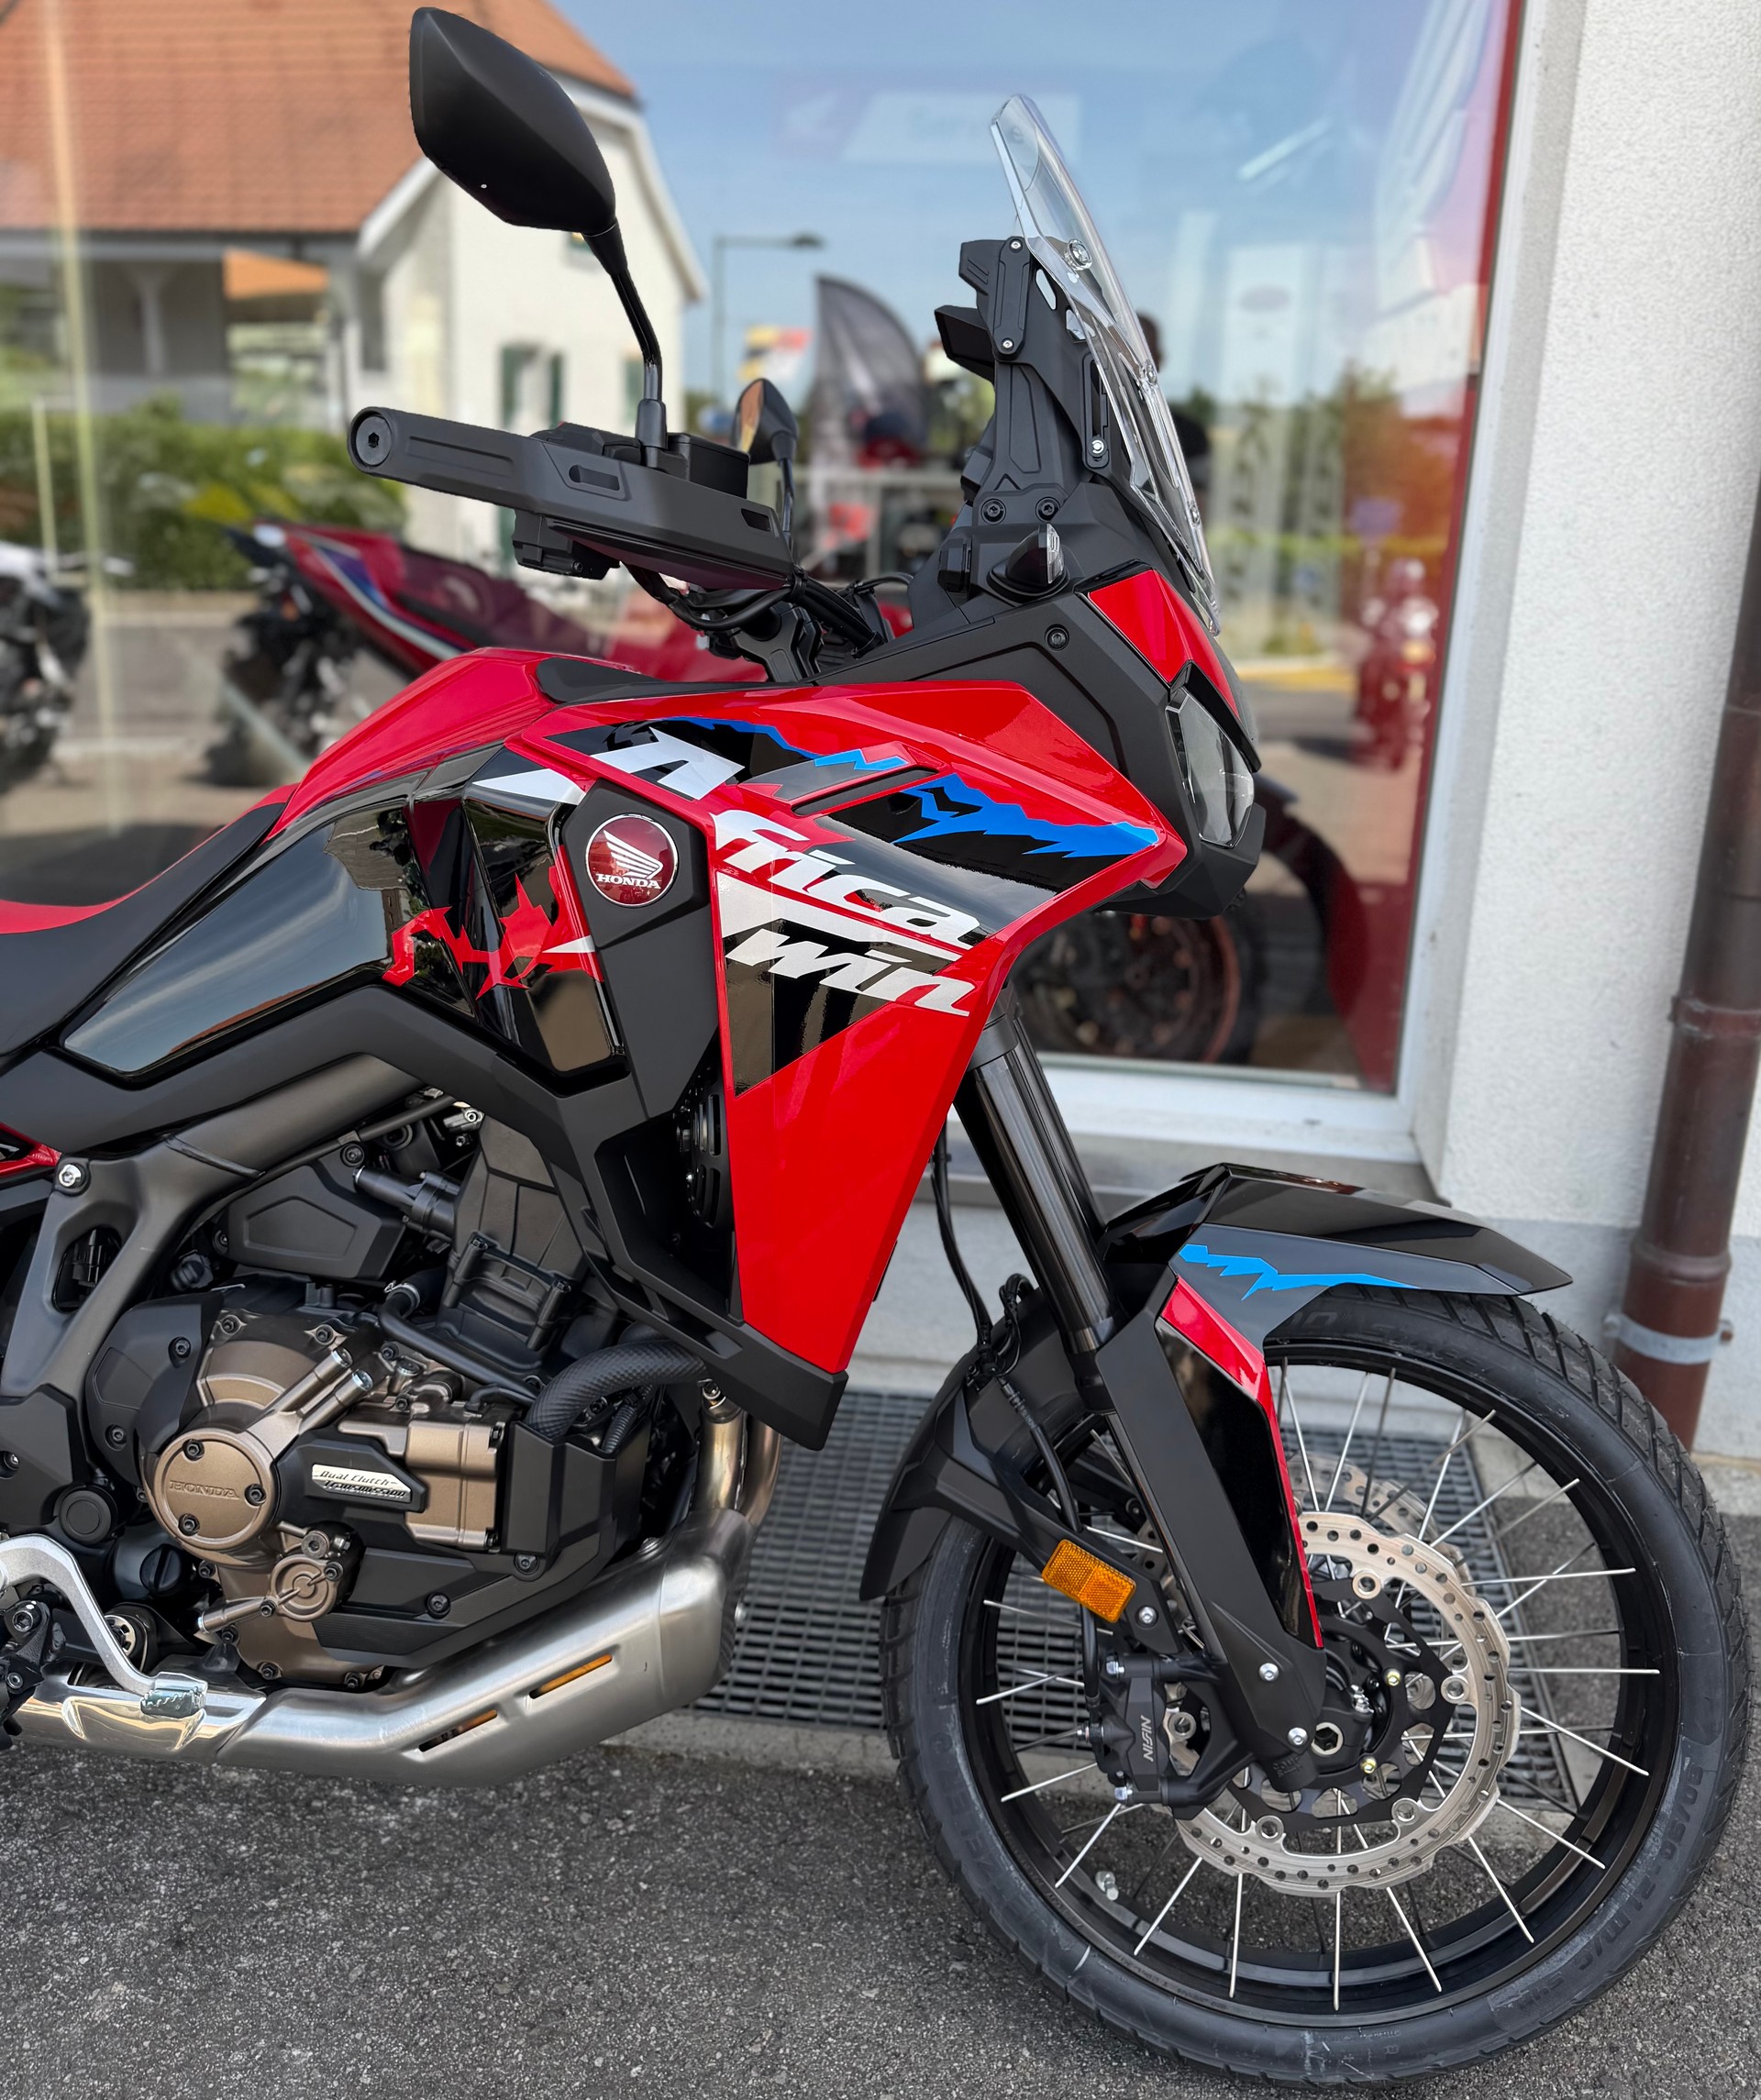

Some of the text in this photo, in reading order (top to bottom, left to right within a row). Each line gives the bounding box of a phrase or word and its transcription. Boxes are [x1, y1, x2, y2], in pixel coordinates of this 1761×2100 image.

[596, 873, 661, 890] HONDA
[319, 1470, 390, 1486] Dual Clutch
[169, 1479, 240, 1500] HONDA
